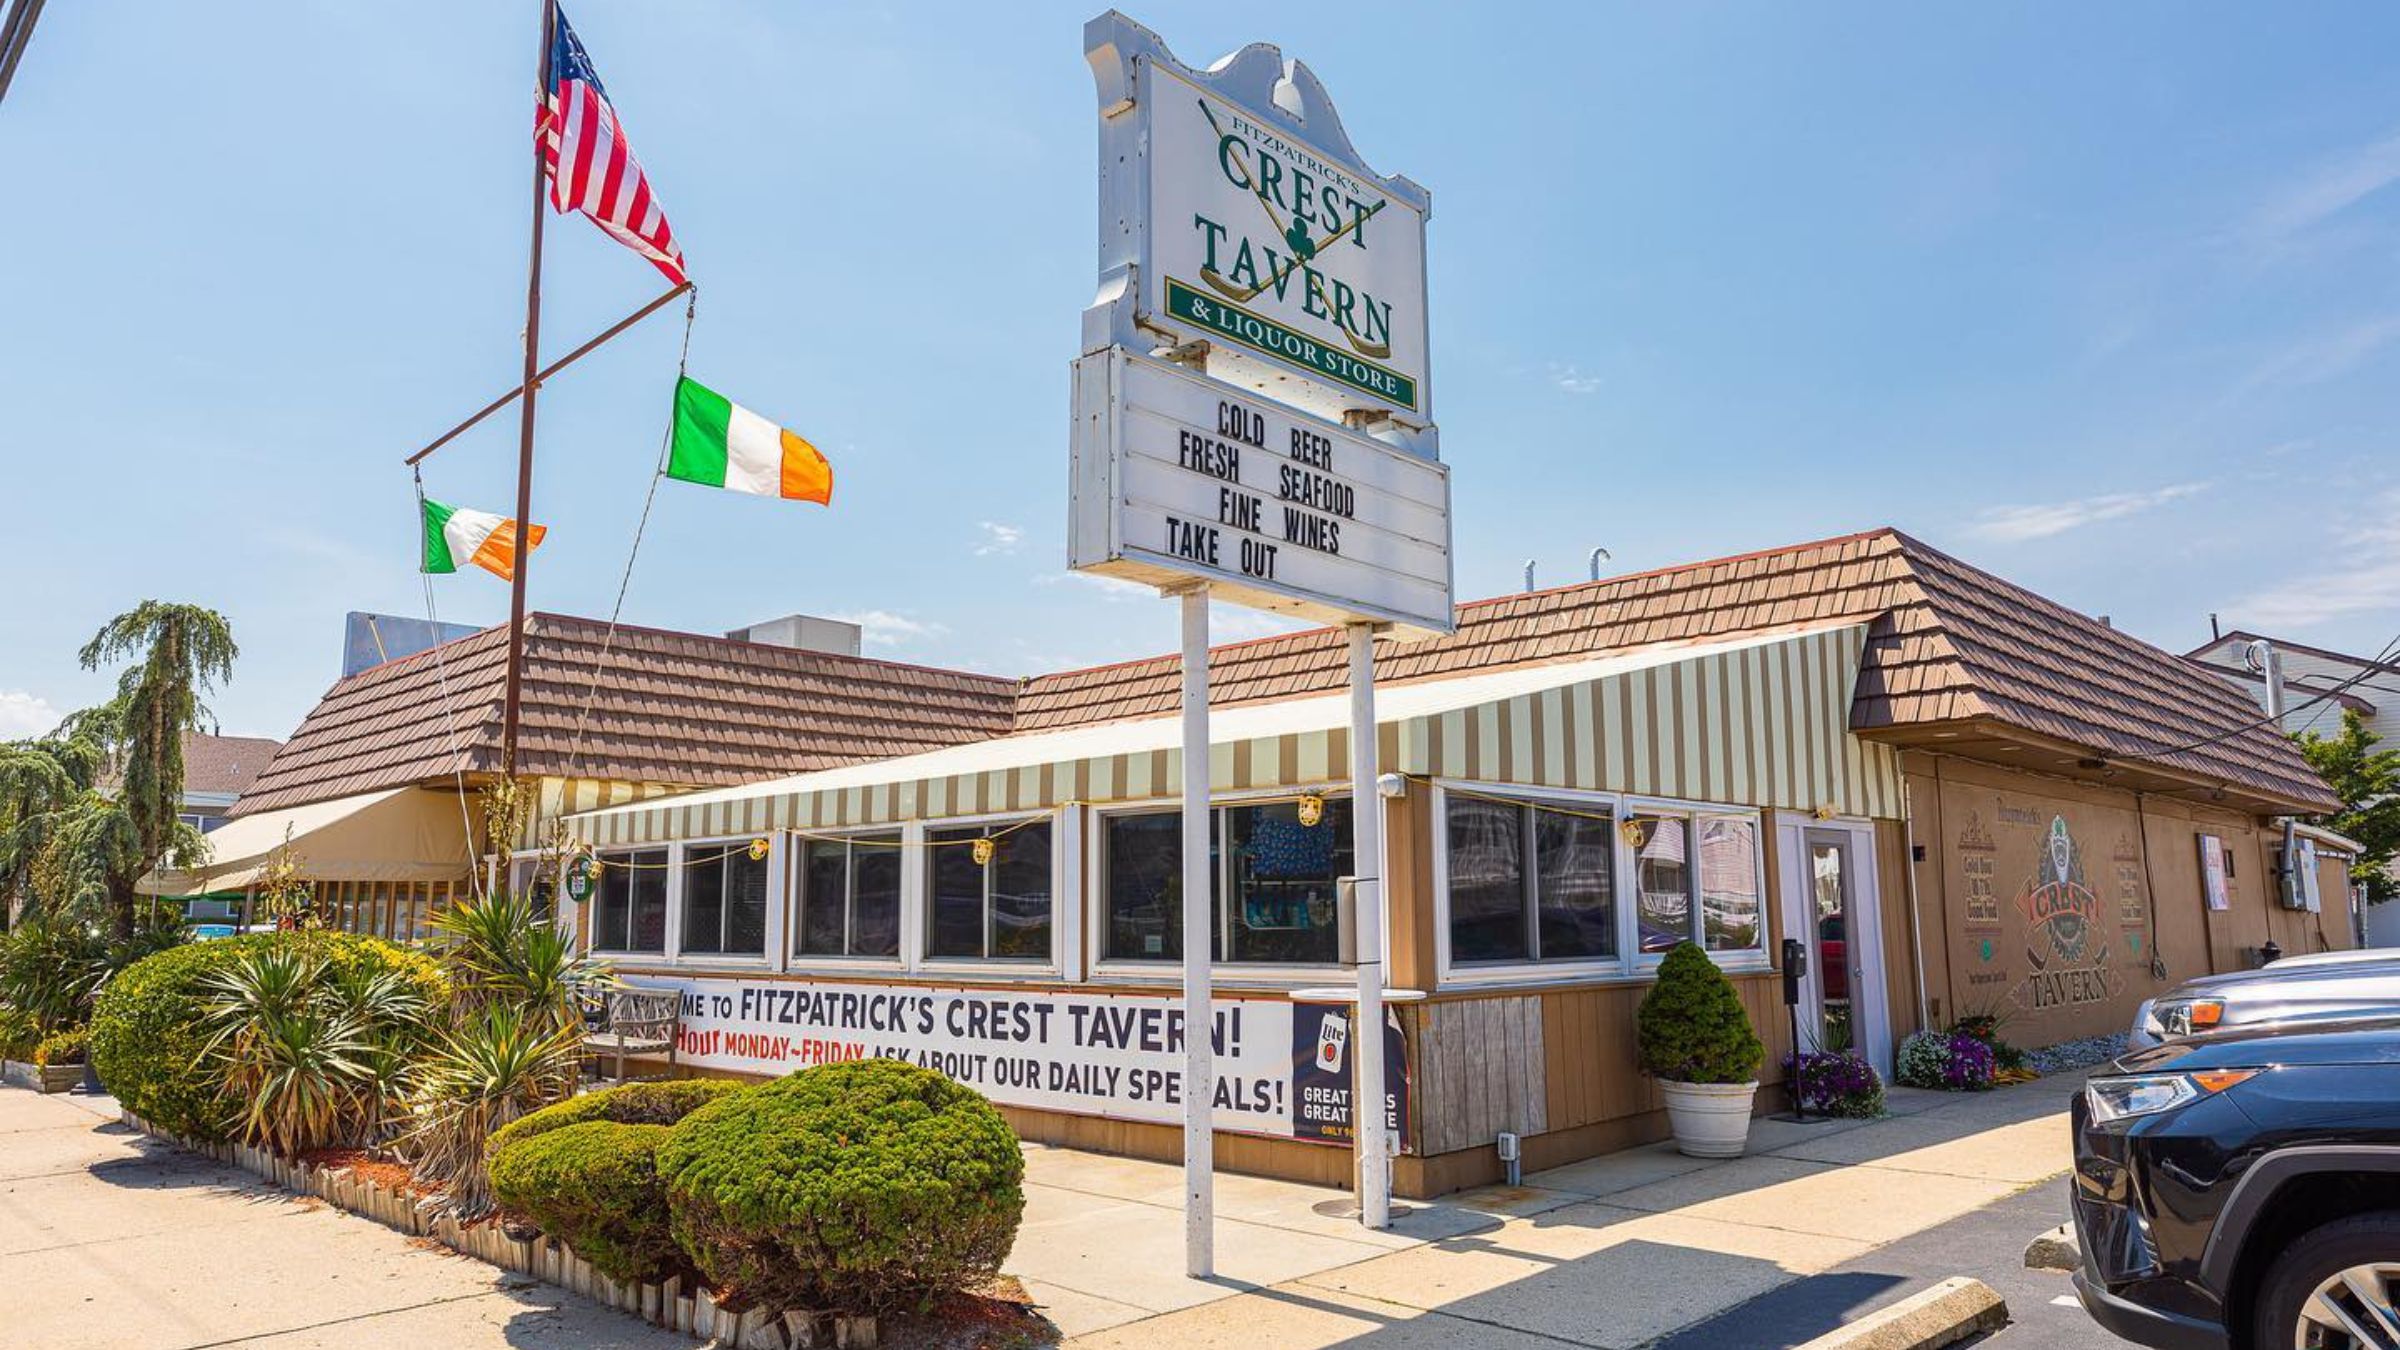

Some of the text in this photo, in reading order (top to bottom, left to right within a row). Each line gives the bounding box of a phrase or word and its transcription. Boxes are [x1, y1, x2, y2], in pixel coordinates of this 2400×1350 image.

[1232, 116, 1360, 195] FITZPATRICK'S
[1218, 133, 1372, 250] CREST
[1194, 213, 1393, 349] TAVERN
[1191, 297, 1398, 395] & LIQUOR STORE
[1218, 400, 1333, 472] COLD BEER
[1179, 429, 1355, 520] FRESH SEAFOOD
[1166, 516, 1277, 580] TAKE OUT
[1219, 487, 1340, 555] FINE WINES
[712, 995, 733, 1019] TO
[740, 987, 935, 1036] FITZPATRICK'S
[945, 998, 1054, 1043] CREST
[2029, 967, 2108, 1008] TAVERN
[1322, 1023, 1345, 1042] Lite
[917, 1049, 988, 1083] ABOUT
[994, 1056, 1041, 1092] OUR
[1048, 1061, 1122, 1098] DAILY
[1128, 1068, 1285, 1115] SPEALS!
[1303, 1086, 1349, 1106] GREAT
[1303, 1103, 1349, 1123] GREAT
